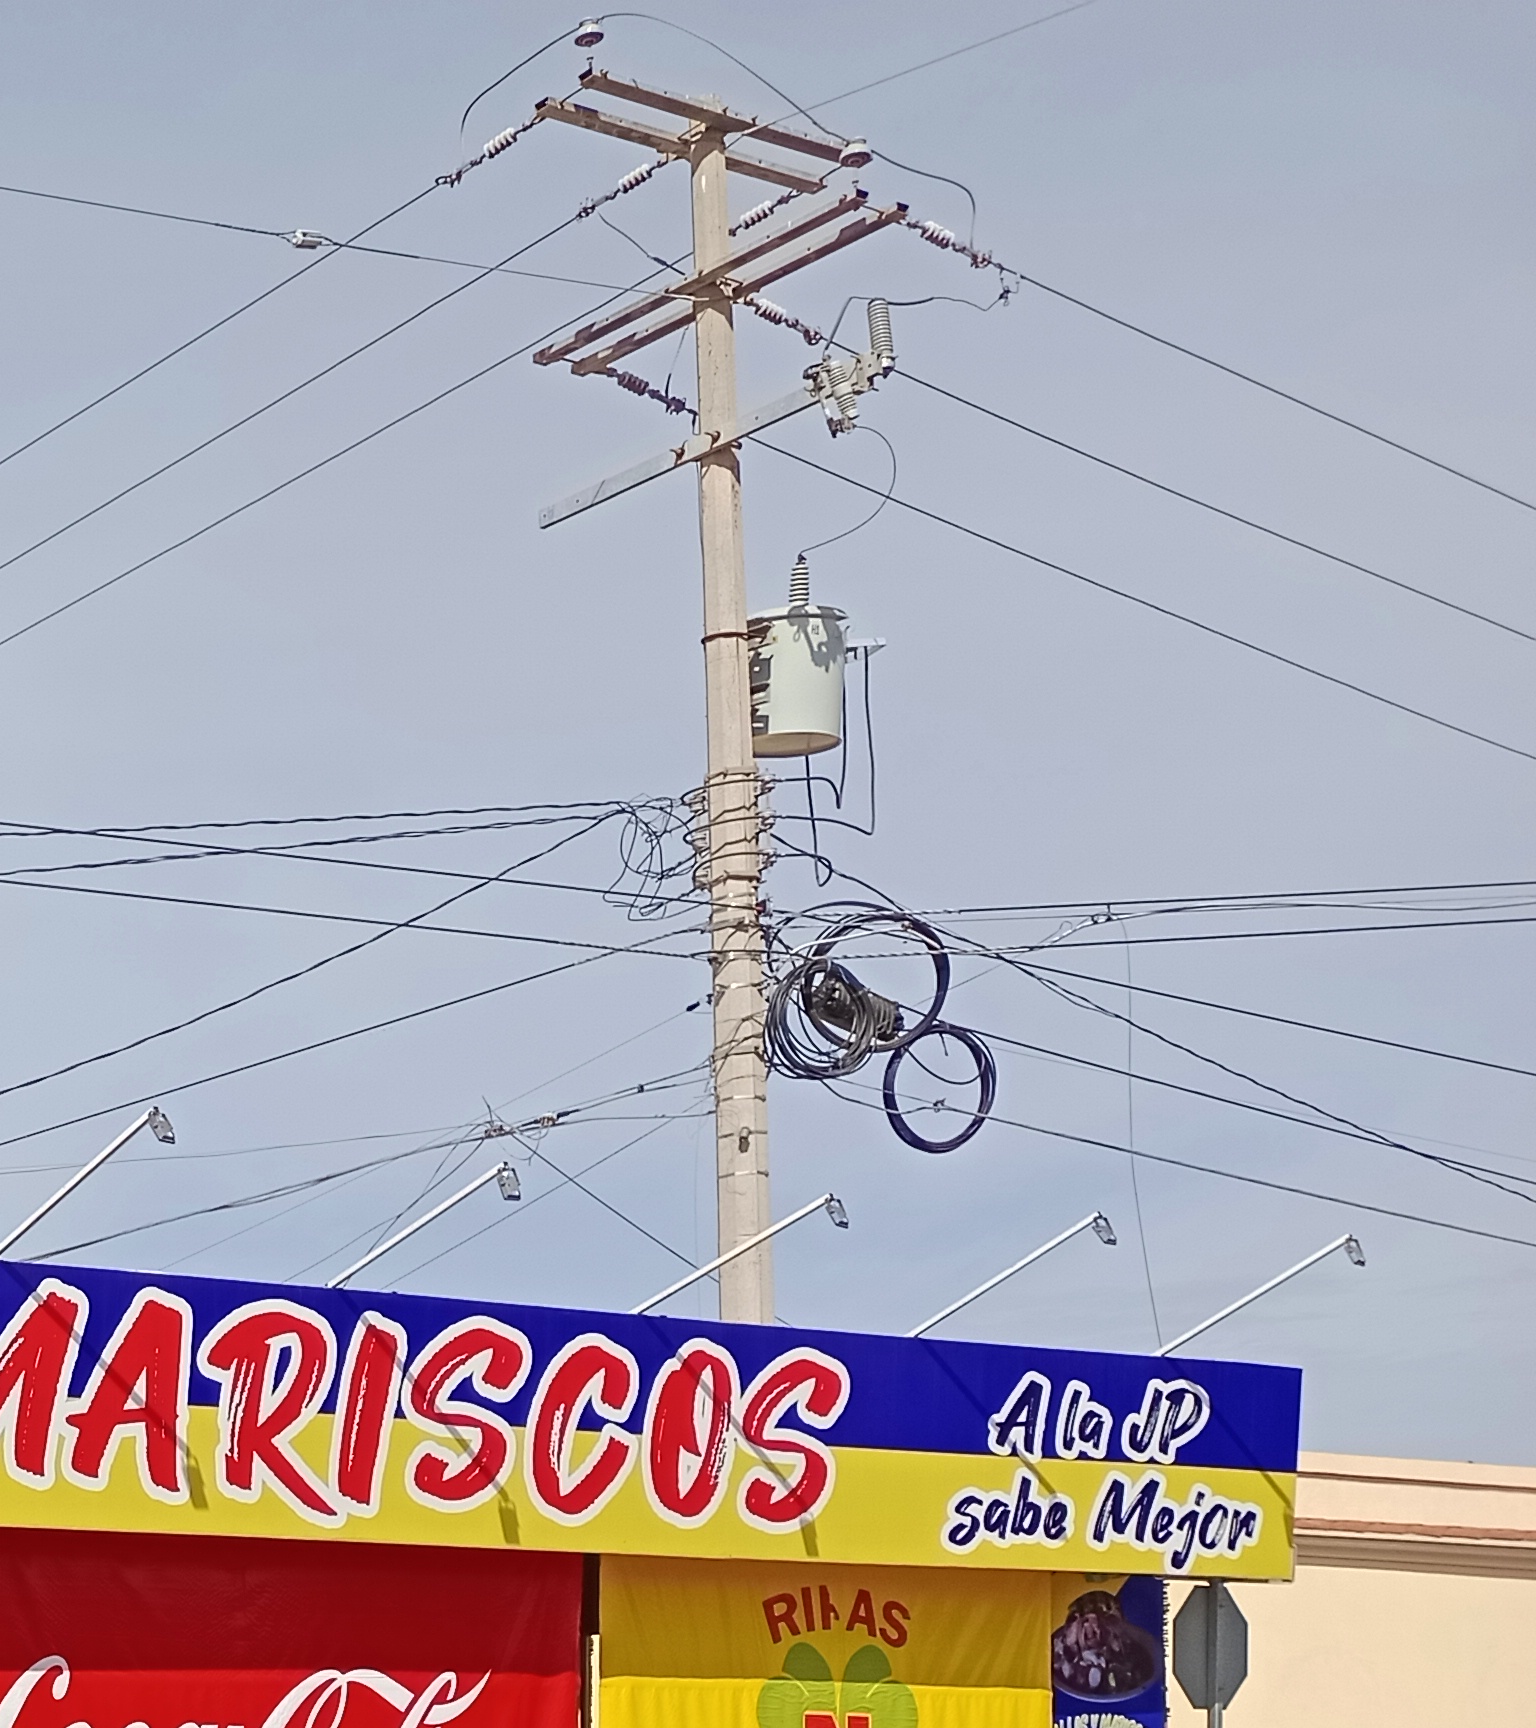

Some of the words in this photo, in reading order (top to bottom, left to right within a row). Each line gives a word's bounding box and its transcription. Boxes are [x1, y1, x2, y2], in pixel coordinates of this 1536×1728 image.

[988, 1371, 1052, 1463] A
[1055, 1379, 1113, 1460] la
[1121, 1378, 1210, 1465] JP
[941, 1468, 1075, 1555] sabe
[1086, 1469, 1263, 1576] Mejor
